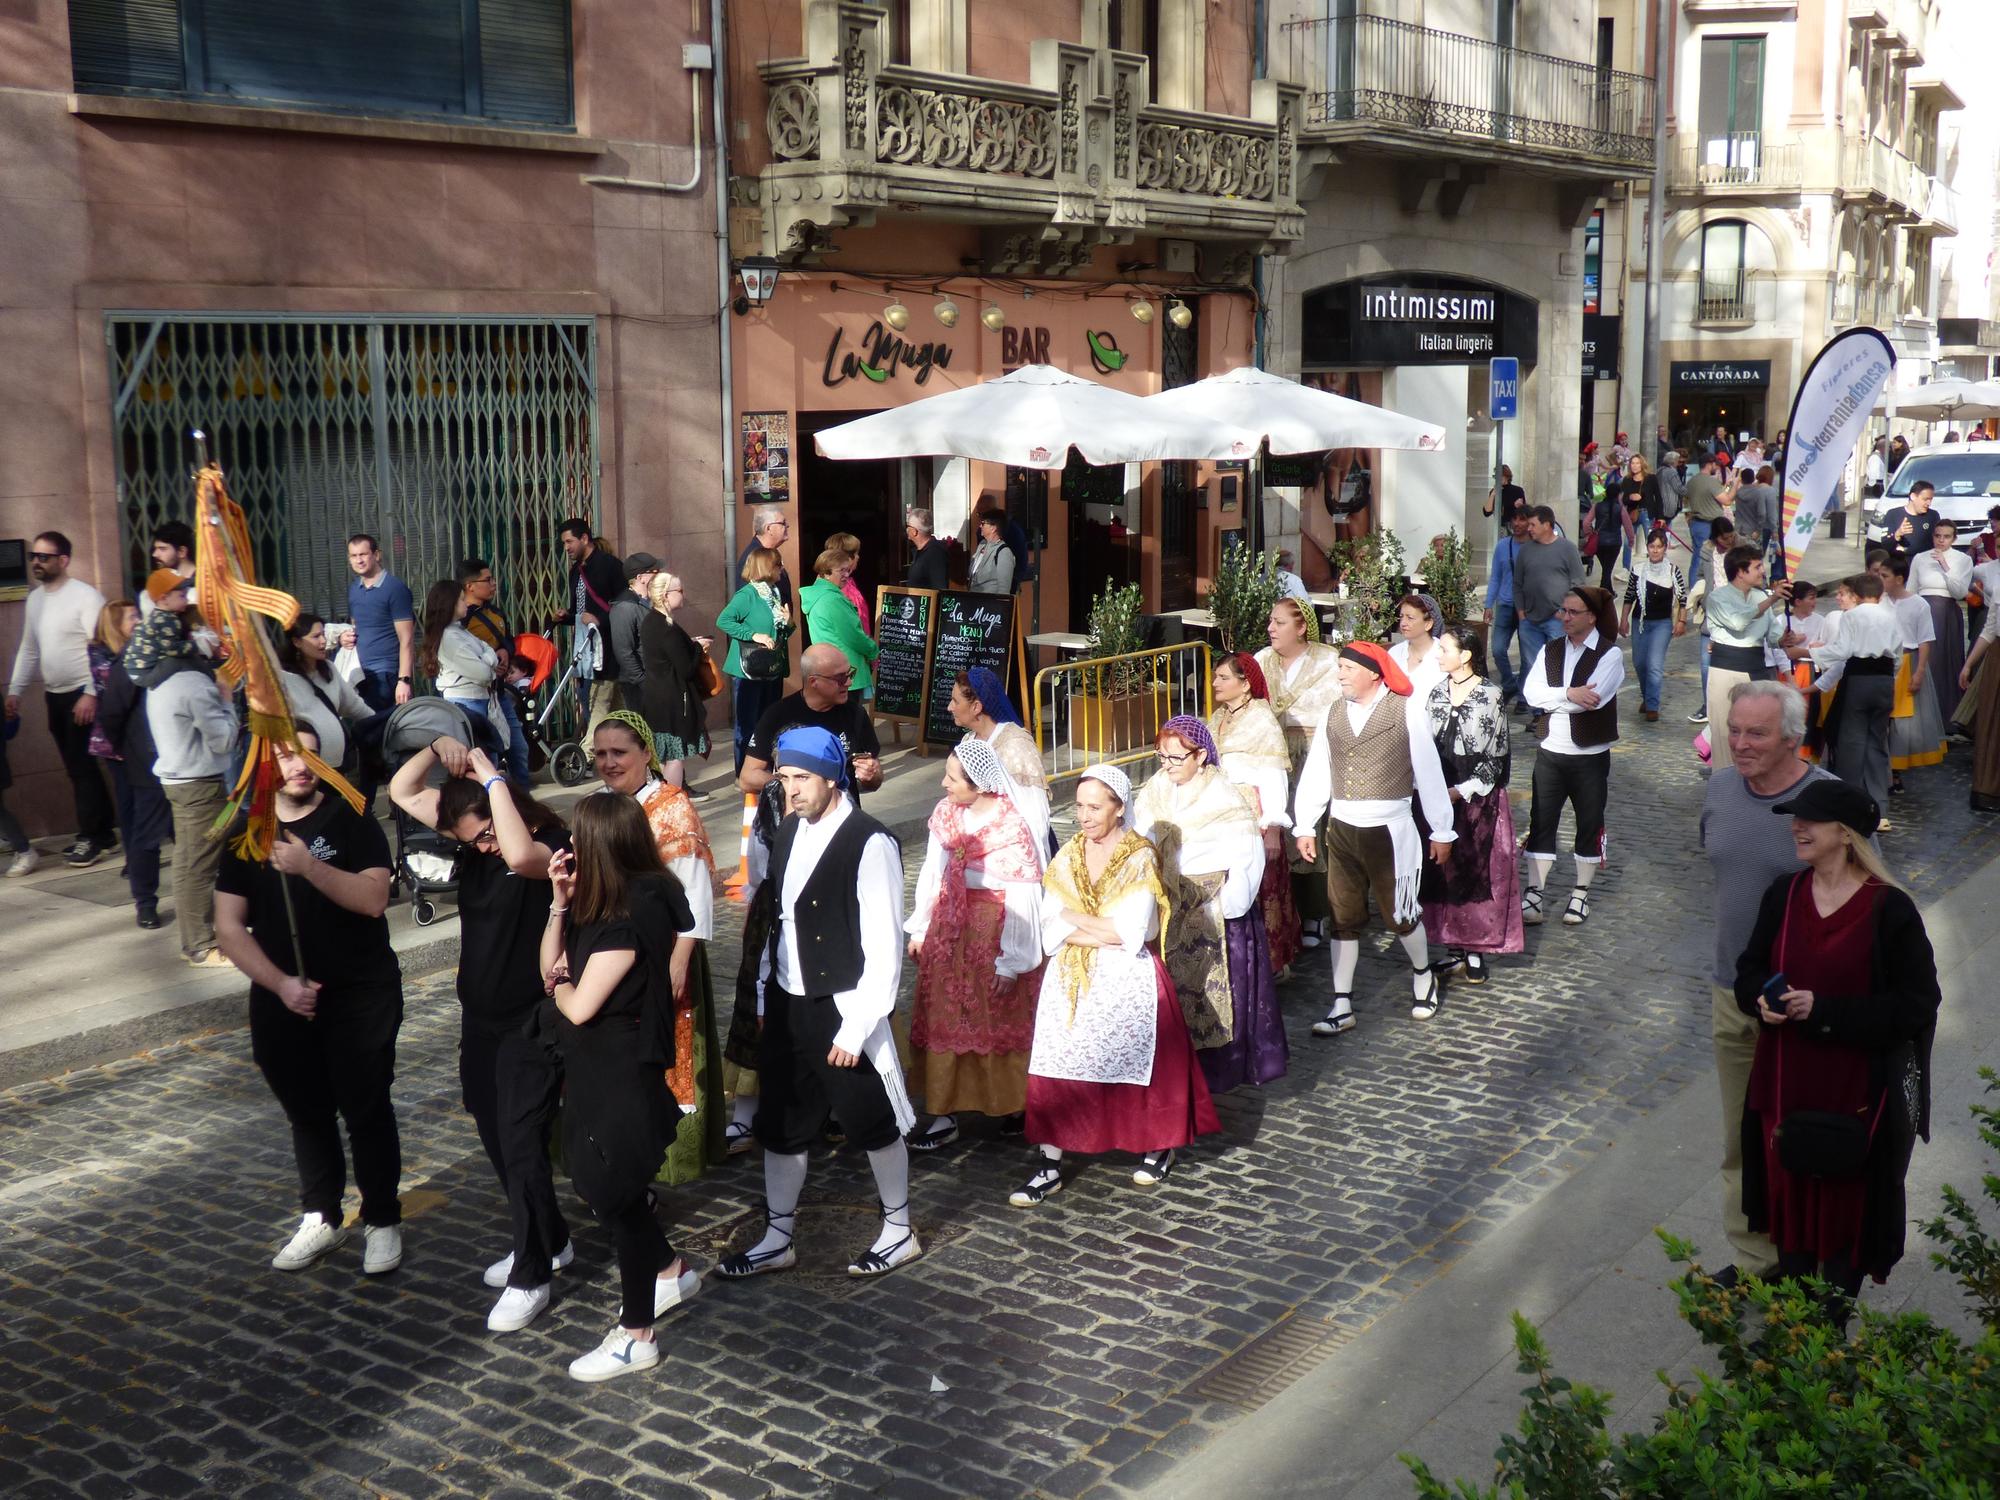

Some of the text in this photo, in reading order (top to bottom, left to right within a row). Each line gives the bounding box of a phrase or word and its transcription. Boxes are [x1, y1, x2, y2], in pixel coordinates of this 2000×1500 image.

[1366, 290, 1495, 321] intimissimi
[822, 320, 953, 387] La Muga
[1002, 326, 1051, 365] BAR
[1420, 332, 1494, 355] Italian lingerie
[1493, 380, 1516, 398] TAXI
[1680, 370, 1761, 381] CANTONADA
[949, 602, 1002, 638] La Muga
